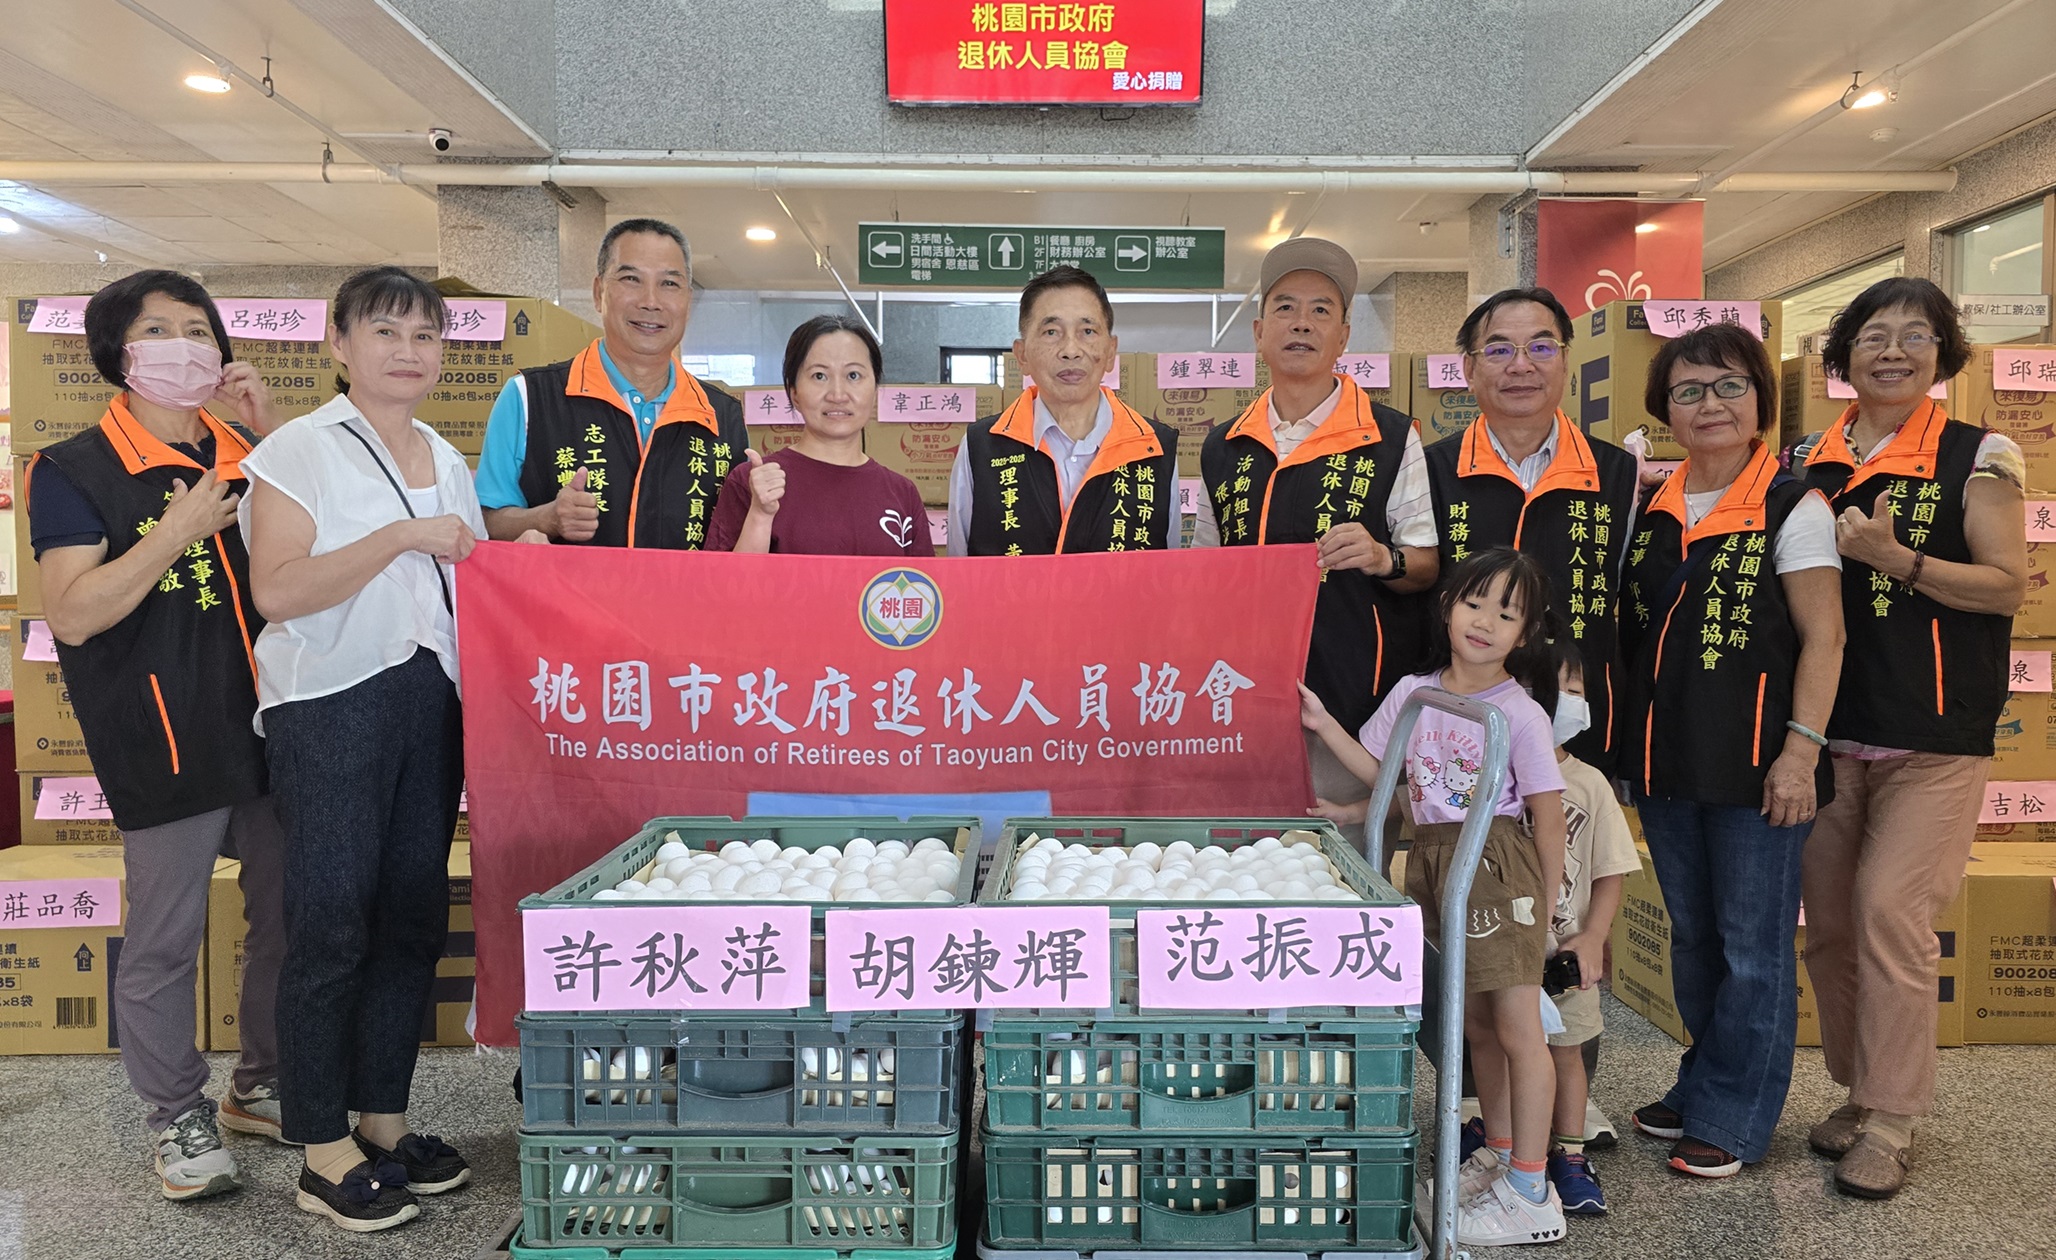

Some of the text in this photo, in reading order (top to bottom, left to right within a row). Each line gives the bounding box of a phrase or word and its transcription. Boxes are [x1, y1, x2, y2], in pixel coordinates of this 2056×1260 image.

[971, 3, 1115, 33] 桃園市政府
[957, 41, 1129, 71] 退休人員協會
[1112, 71, 1183, 91] 愛心捐贈
[911, 233, 942, 245] 洗手間
[1033, 235, 1045, 245] B1
[1155, 236, 1196, 248] 視聽教室
[911, 259, 942, 269] 男宿舍
[1034, 247, 1106, 258] 2F 財務辦公室
[1155, 247, 1189, 259] 辦公室
[911, 270, 932, 281] 電梯
[231, 308, 307, 332] 呂瑞珍
[1662, 306, 1741, 329] 邱秀蘭
[1169, 357, 1241, 380] 鍾翠連
[272, 395, 321, 406] 8包x8袋
[891, 392, 962, 414] 韋正鴻
[1166, 407, 1205, 417] 防漏安心
[1996, 409, 2043, 421] 防漏安心
[912, 434, 951, 443] 防漏安心
[999, 467, 1021, 532] 理事長
[1134, 464, 1156, 552] 桃園市政
[1233, 454, 1254, 540] 活動組長
[1314, 454, 1348, 543] 退休人員
[1448, 501, 1471, 562] 財務長
[1589, 502, 1612, 617] 桃園市政府
[1629, 530, 1653, 567] 理事
[1869, 480, 1908, 617] 退休協會
[1568, 500, 1589, 639] 退休人員協會
[1699, 533, 1740, 670] 退休人員協會
[1726, 532, 1767, 650] 桃園市政府
[879, 597, 923, 620] 桃園
[2010, 660, 2035, 684] 泉
[529, 657, 1256, 737] 桃園市政府退休人員協會
[545, 731, 1244, 771] The Association of Retirees of Taoyuan City Government
[1990, 792, 2046, 816] 吉松
[2, 890, 100, 921] 莊品喬
[1166, 910, 1403, 983] 范振成
[1628, 928, 1661, 956] 9002085
[543, 921, 787, 1002] 許秋萍
[849, 927, 1089, 1004] 胡鍊輝
[0, 995, 33, 1007] x8袋
